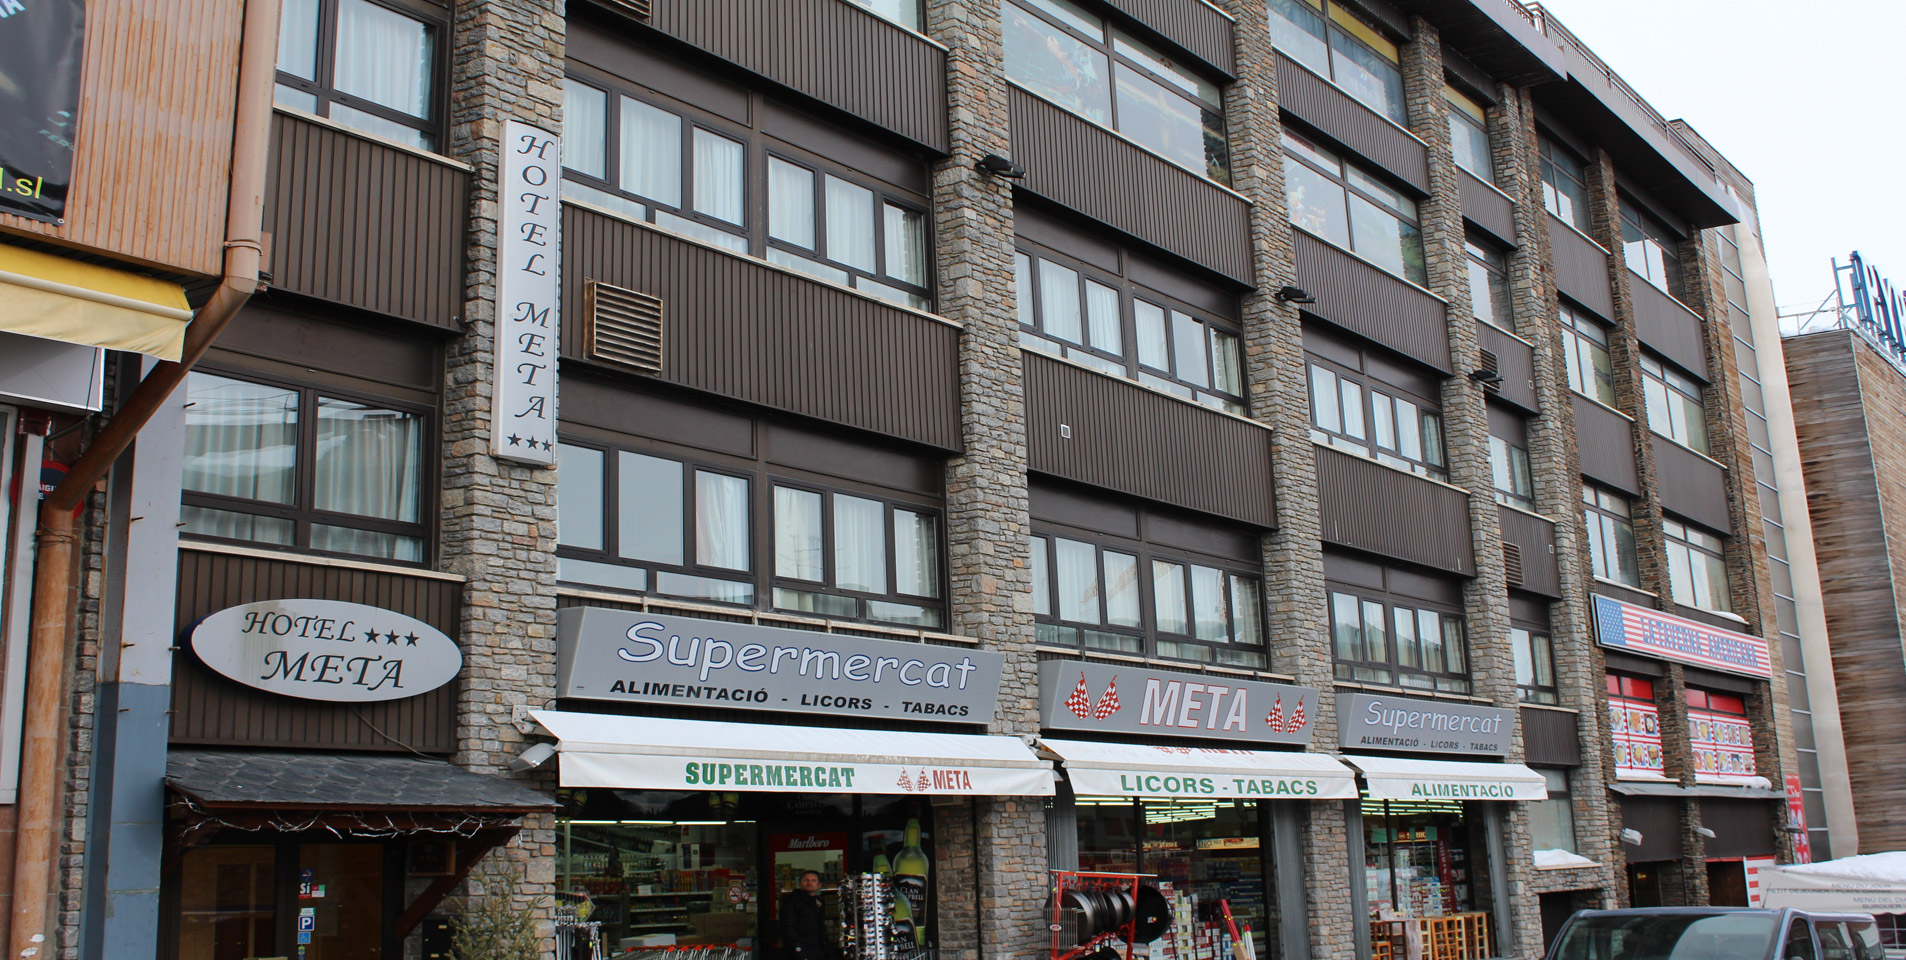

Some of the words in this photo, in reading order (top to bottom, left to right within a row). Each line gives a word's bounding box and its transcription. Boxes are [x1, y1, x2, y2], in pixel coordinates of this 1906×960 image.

[517, 134, 554, 277] HOTEL
[513, 301, 551, 420] META
[241, 611, 356, 643] HOTEL
[260, 650, 405, 691] META
[617, 621, 977, 690] Supermercat
[609, 679, 769, 703] ALIMENTACIÓ
[800, 693, 873, 710] LICORS
[901, 701, 969, 716] TABACS
[1138, 677, 1248, 732] META
[1364, 700, 1502, 735] Supermercat
[1430, 740, 1459, 750] LICORS
[1469, 742, 1498, 752] TABACS
[685, 762, 855, 788] SUPERMERCAT
[932, 769, 973, 790] META
[1120, 774, 1215, 794] LICORS
[1232, 778, 1319, 796] TABACS
[787, 835, 830, 849] Marlboro
[299, 882, 311, 894] Sí
[301, 917, 312, 930] P
